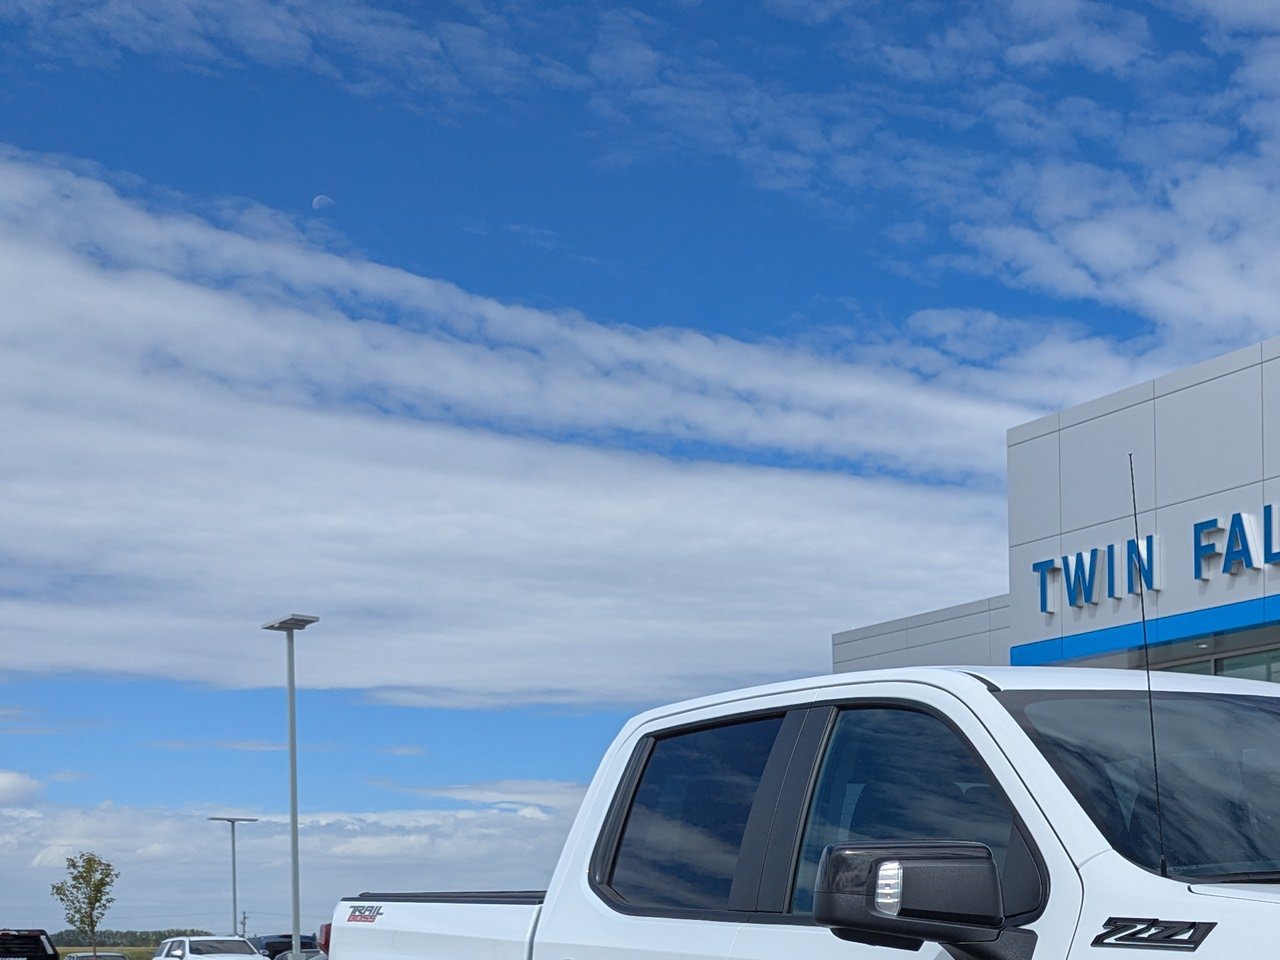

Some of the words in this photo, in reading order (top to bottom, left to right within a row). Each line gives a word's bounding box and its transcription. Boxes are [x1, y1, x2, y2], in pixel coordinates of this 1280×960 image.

[1032, 533, 1160, 614] TWIN
[347, 914, 377, 922] BOSS
[349, 905, 384, 915] TRAIL
[1090, 916, 1218, 952] Z71
